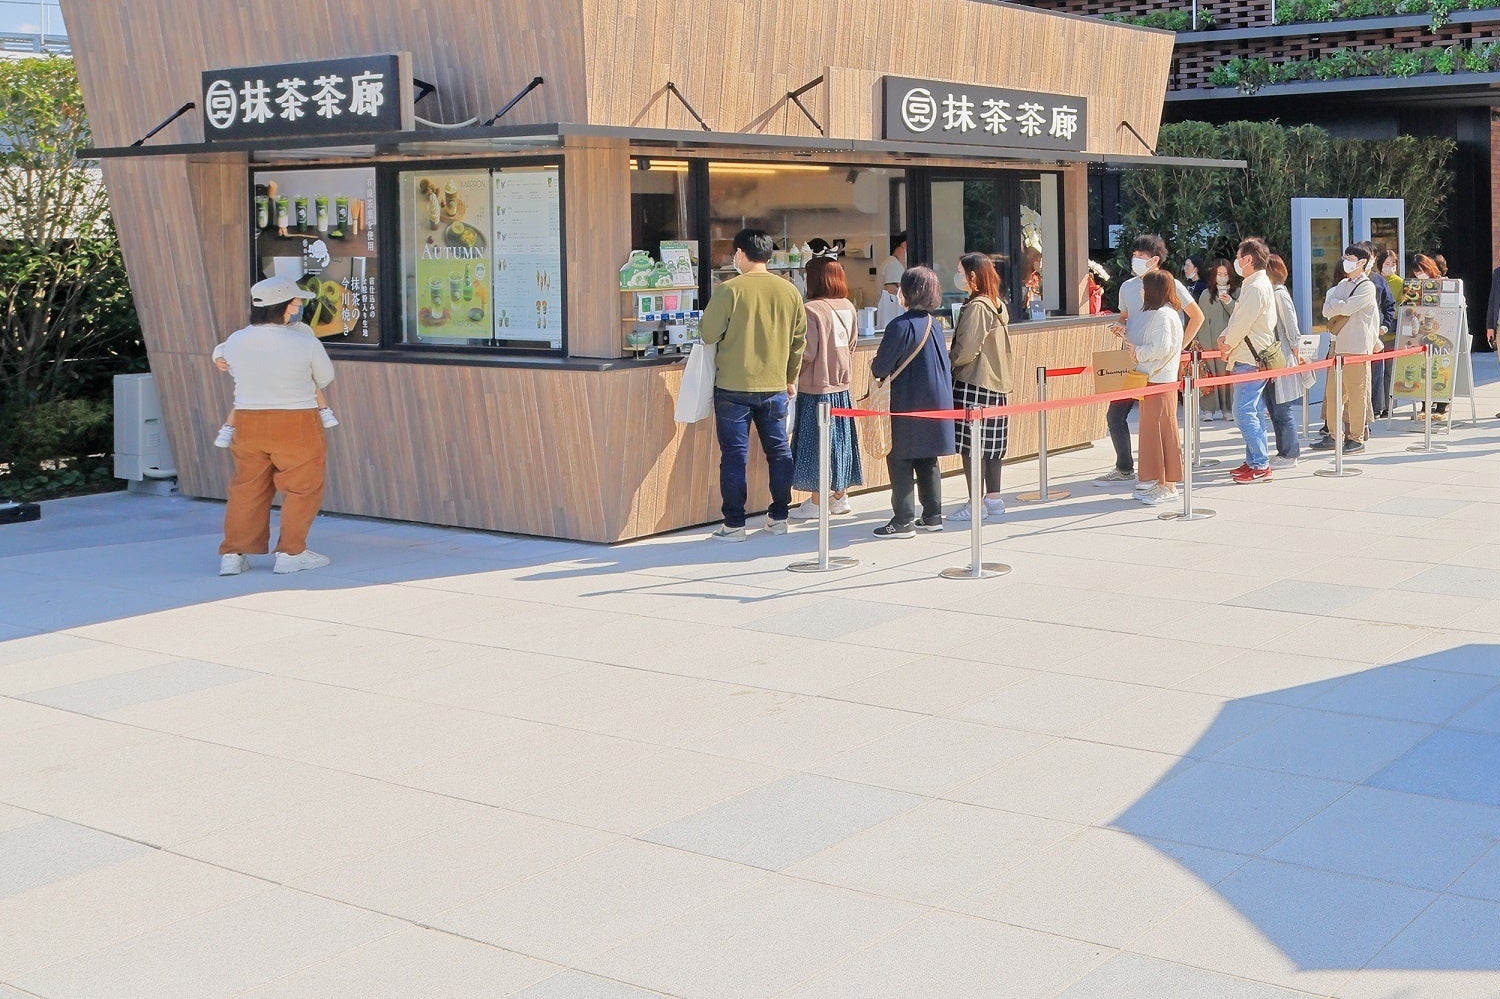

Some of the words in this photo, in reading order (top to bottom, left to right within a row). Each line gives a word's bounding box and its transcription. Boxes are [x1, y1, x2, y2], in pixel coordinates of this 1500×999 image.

[240, 70, 384, 124] 抹茶茶廊
[942, 93, 1078, 140] 抹茶茶廊
[421, 243, 484, 260] AUTUMN
[350, 276, 360, 320] 抹茶の
[1096, 368, 1129, 377] Champi
